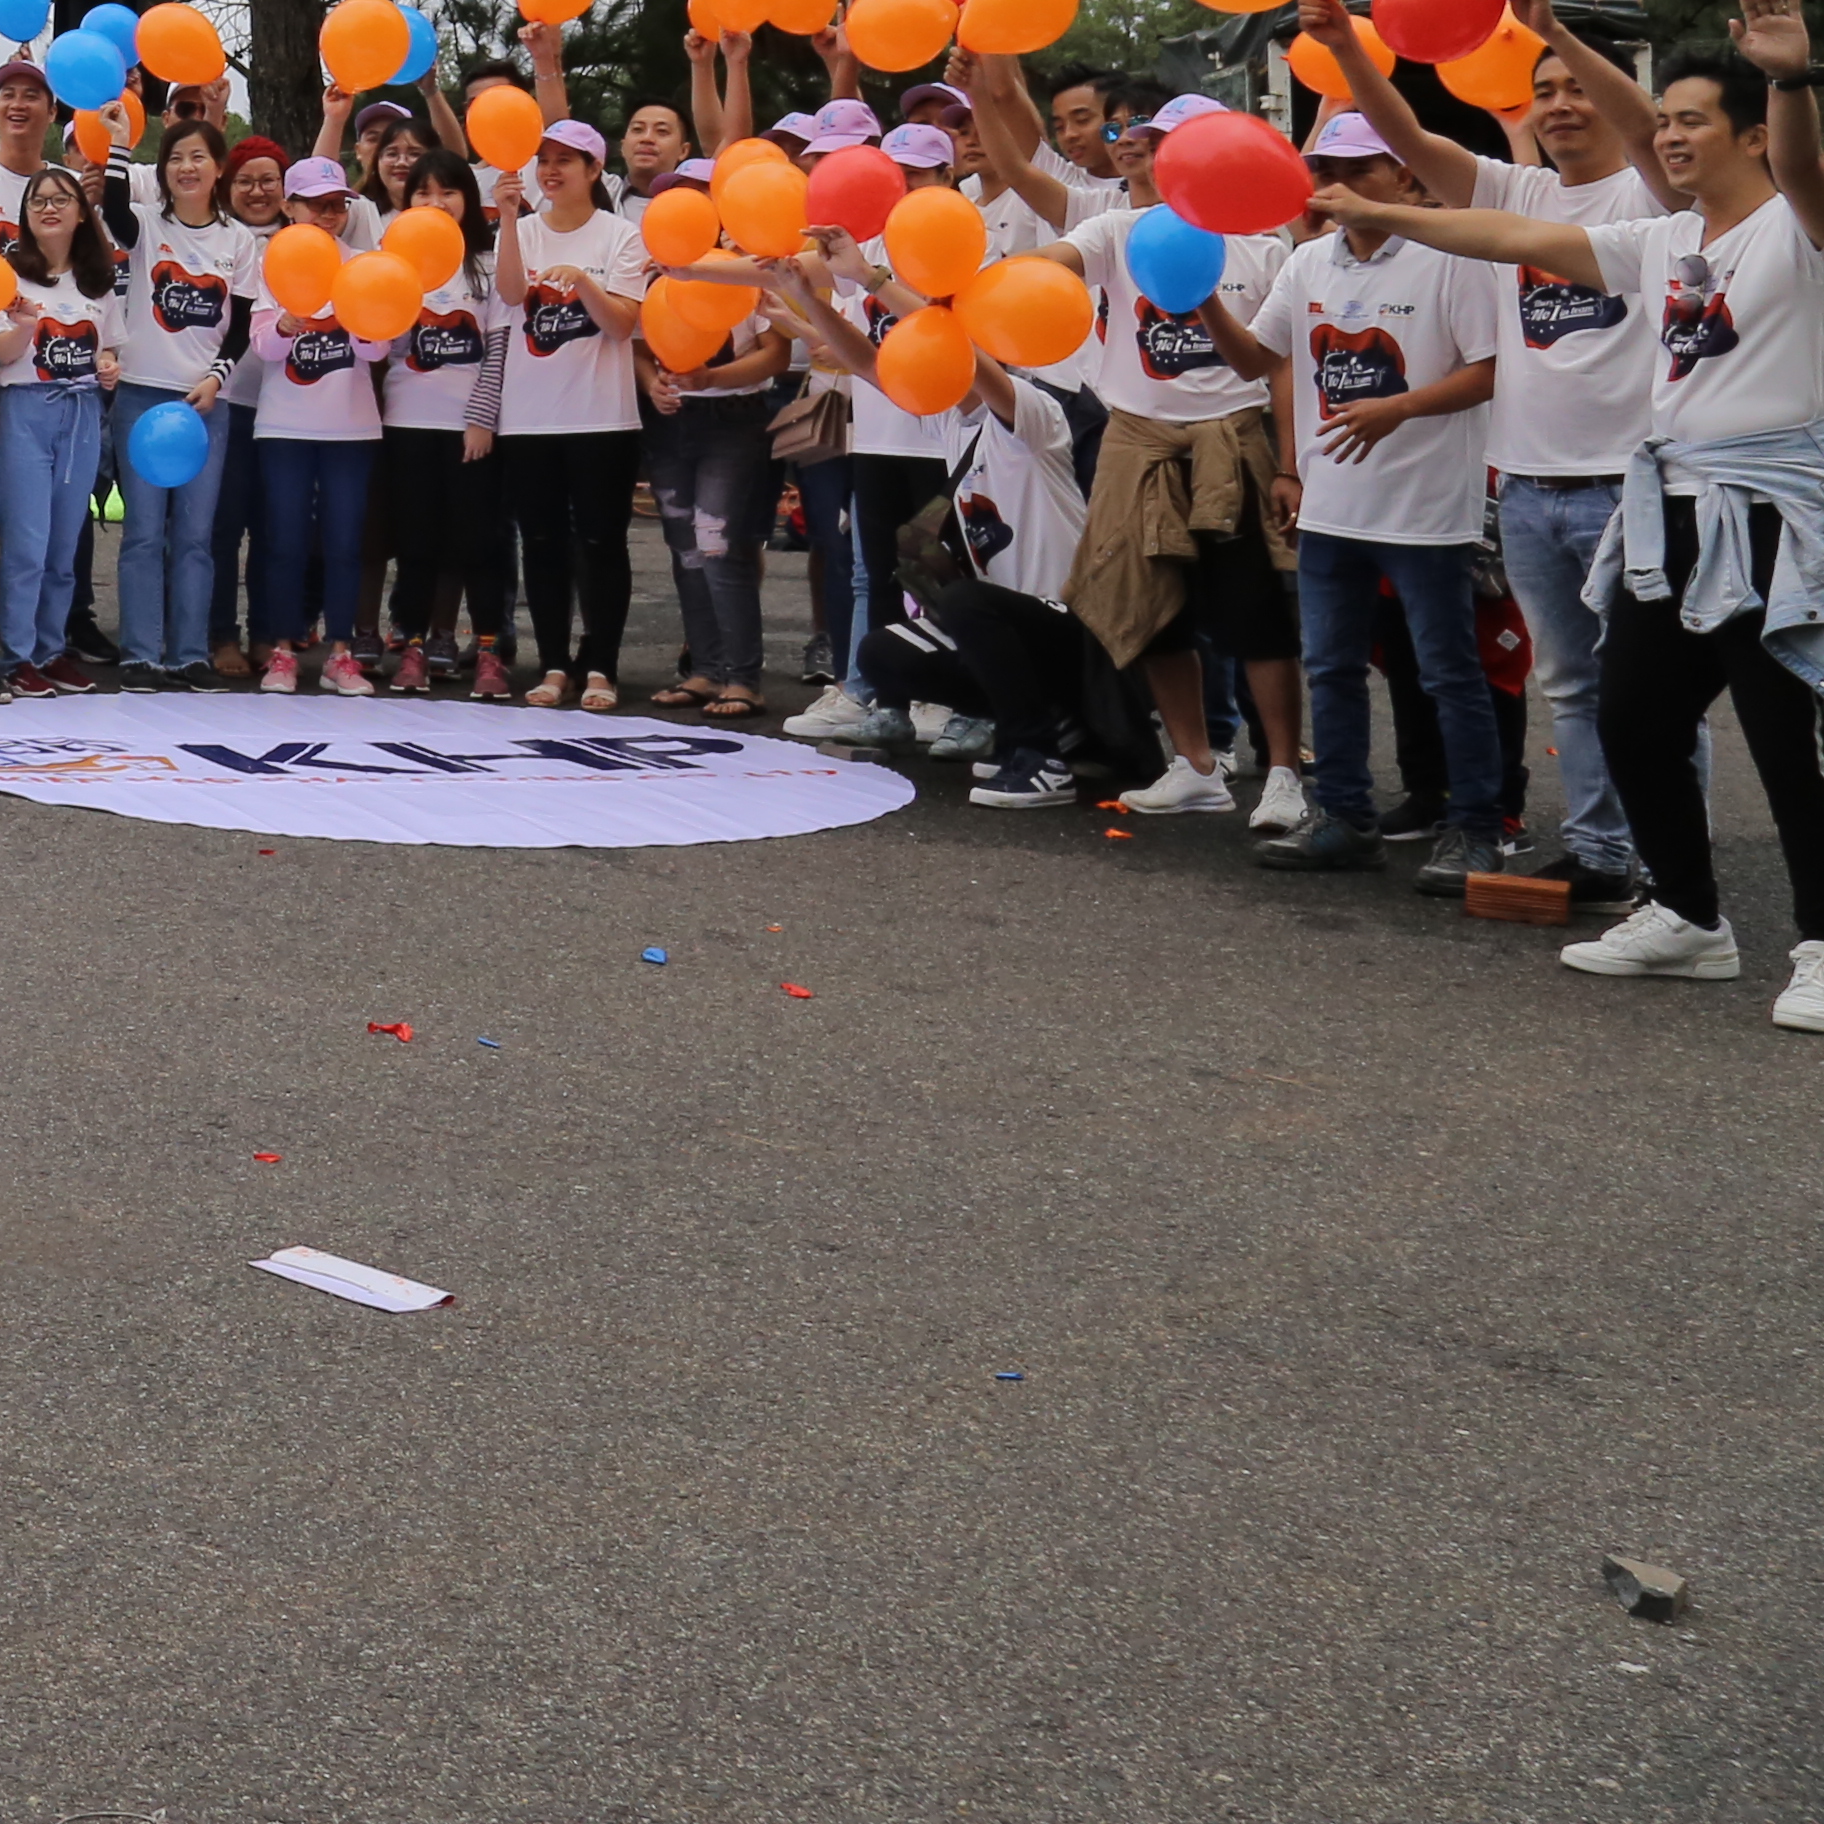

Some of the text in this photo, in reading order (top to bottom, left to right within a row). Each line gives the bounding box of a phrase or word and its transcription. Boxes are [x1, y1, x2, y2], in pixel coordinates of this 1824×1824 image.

[1222, 283, 1246, 292] KHP
[1389, 304, 1414, 315] KHP
[1531, 307, 1551, 321] No
[1155, 339, 1173, 352] No
[174, 735, 744, 774] KHP
